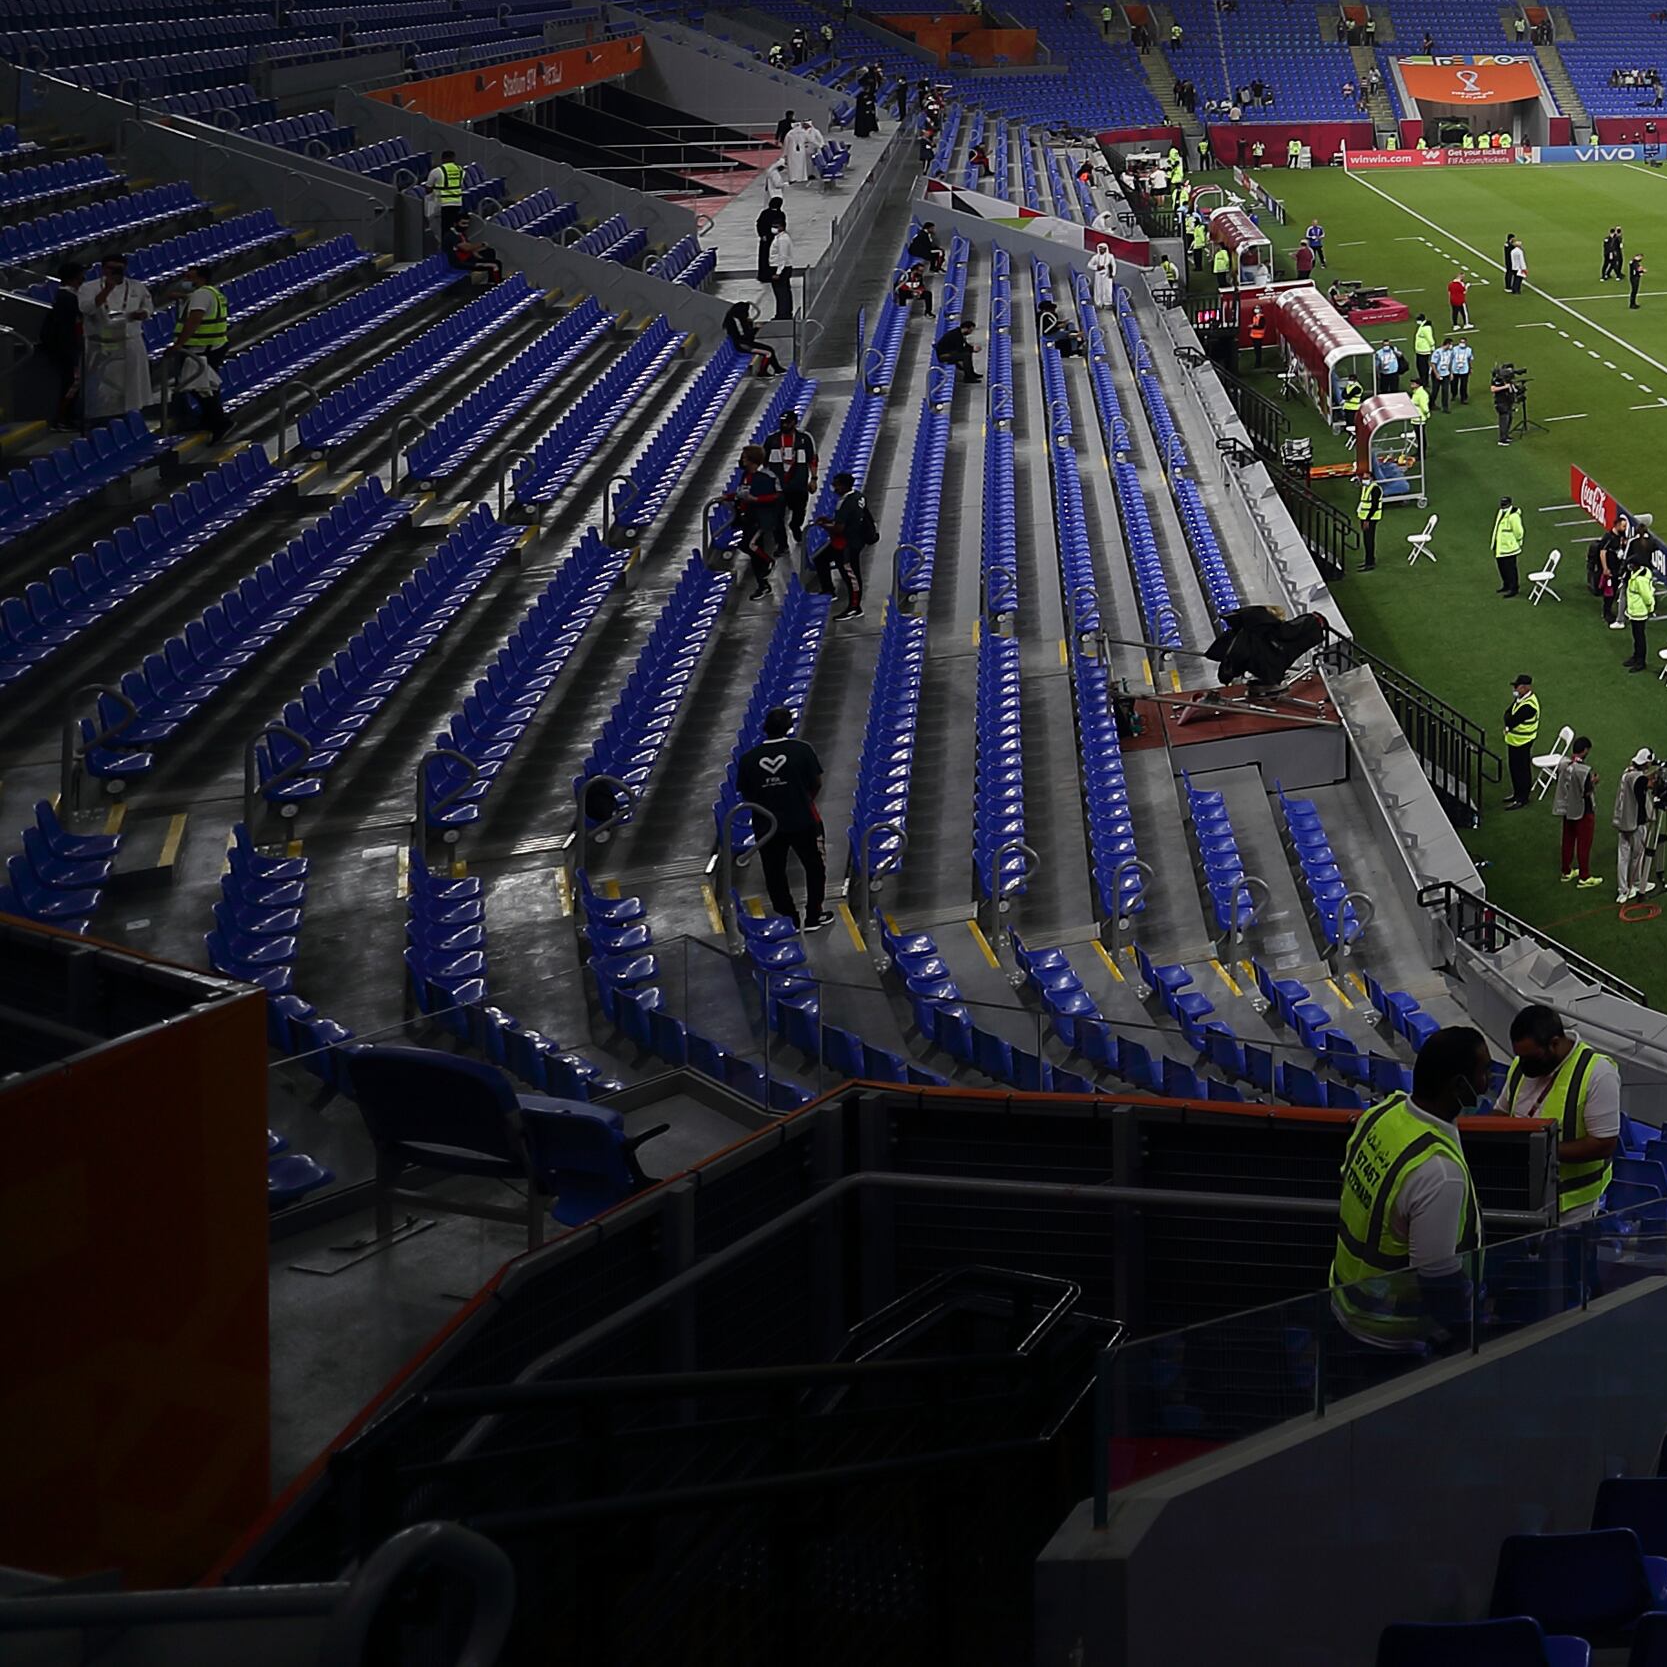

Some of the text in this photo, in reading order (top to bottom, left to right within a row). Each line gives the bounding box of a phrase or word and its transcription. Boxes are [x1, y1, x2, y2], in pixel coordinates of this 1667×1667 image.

[1350, 153, 1412, 164] winwin.com
[1575, 145, 1635, 161] vivo
[1448, 156, 1510, 165] FIFA.com/tickets
[1355, 1150, 1380, 1187] 97467
